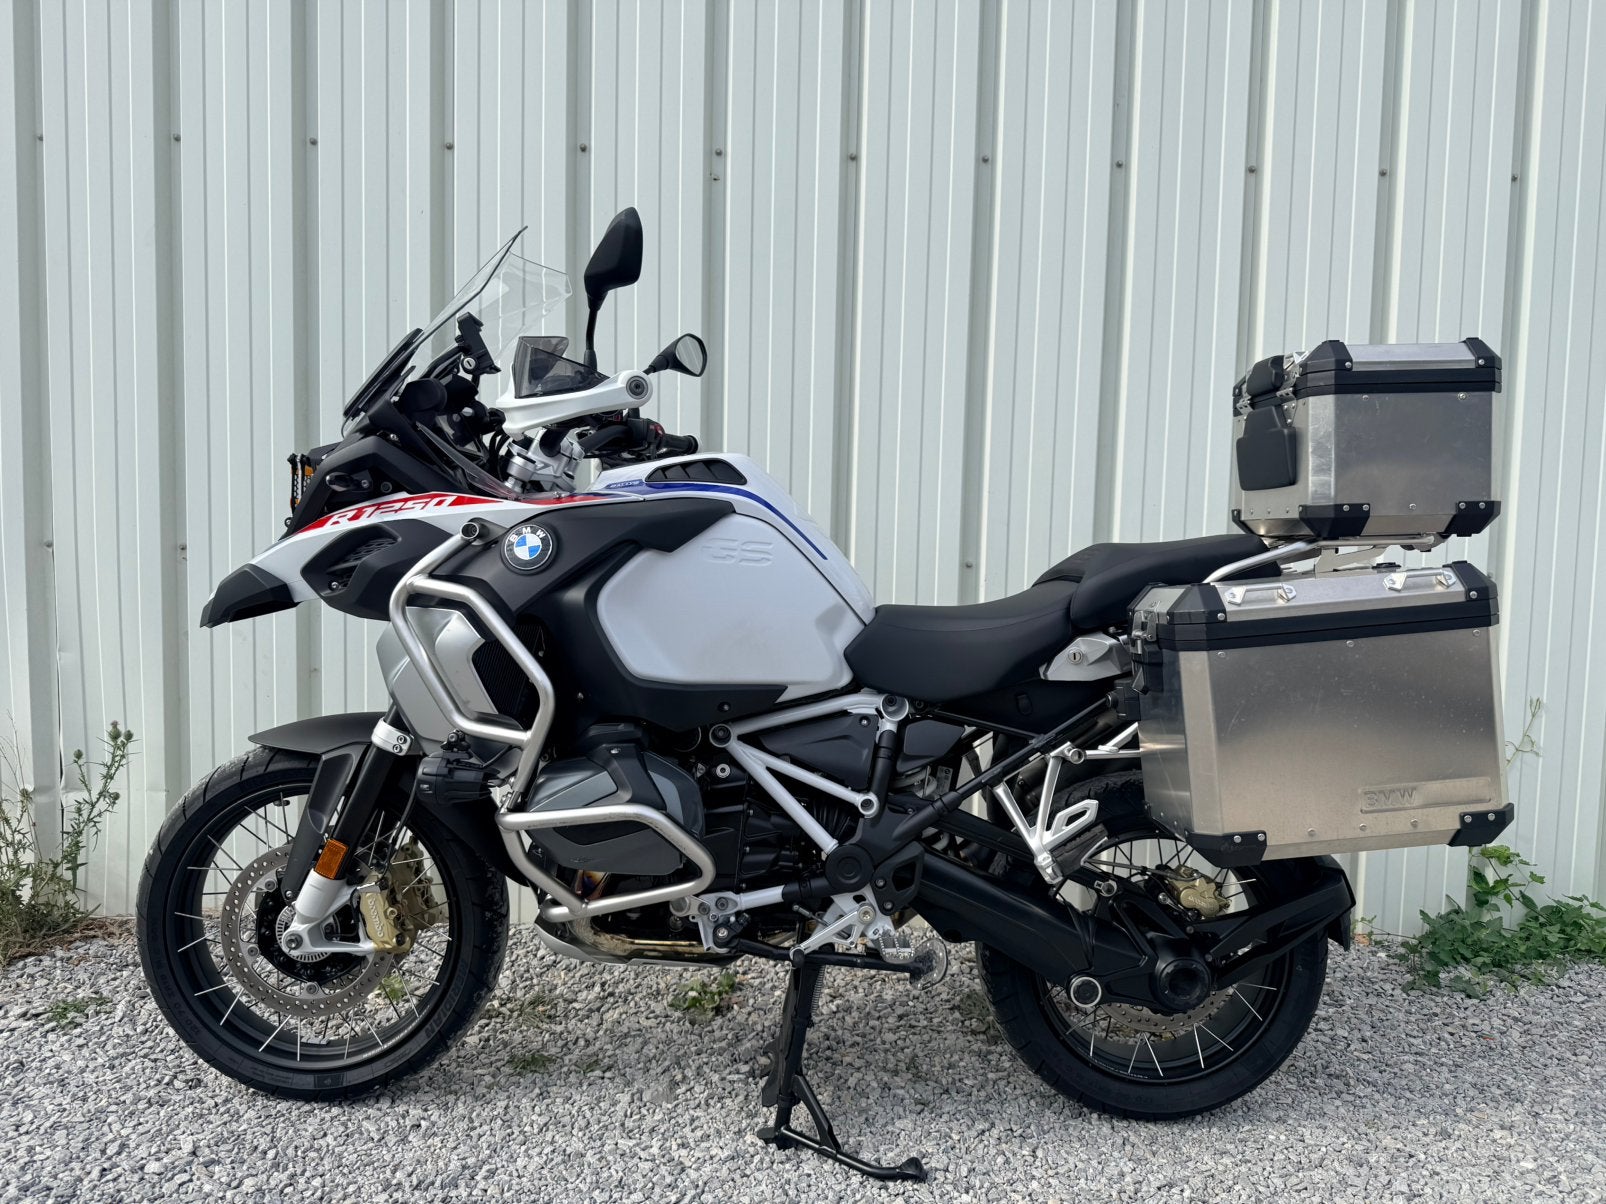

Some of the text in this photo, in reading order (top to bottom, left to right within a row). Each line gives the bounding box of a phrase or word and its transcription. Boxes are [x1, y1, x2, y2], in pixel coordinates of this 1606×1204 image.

[508, 526, 546, 543] BMW
[701, 537, 775, 567] GS
[1364, 787, 1418, 809] BMW
[367, 897, 385, 938] brembo
